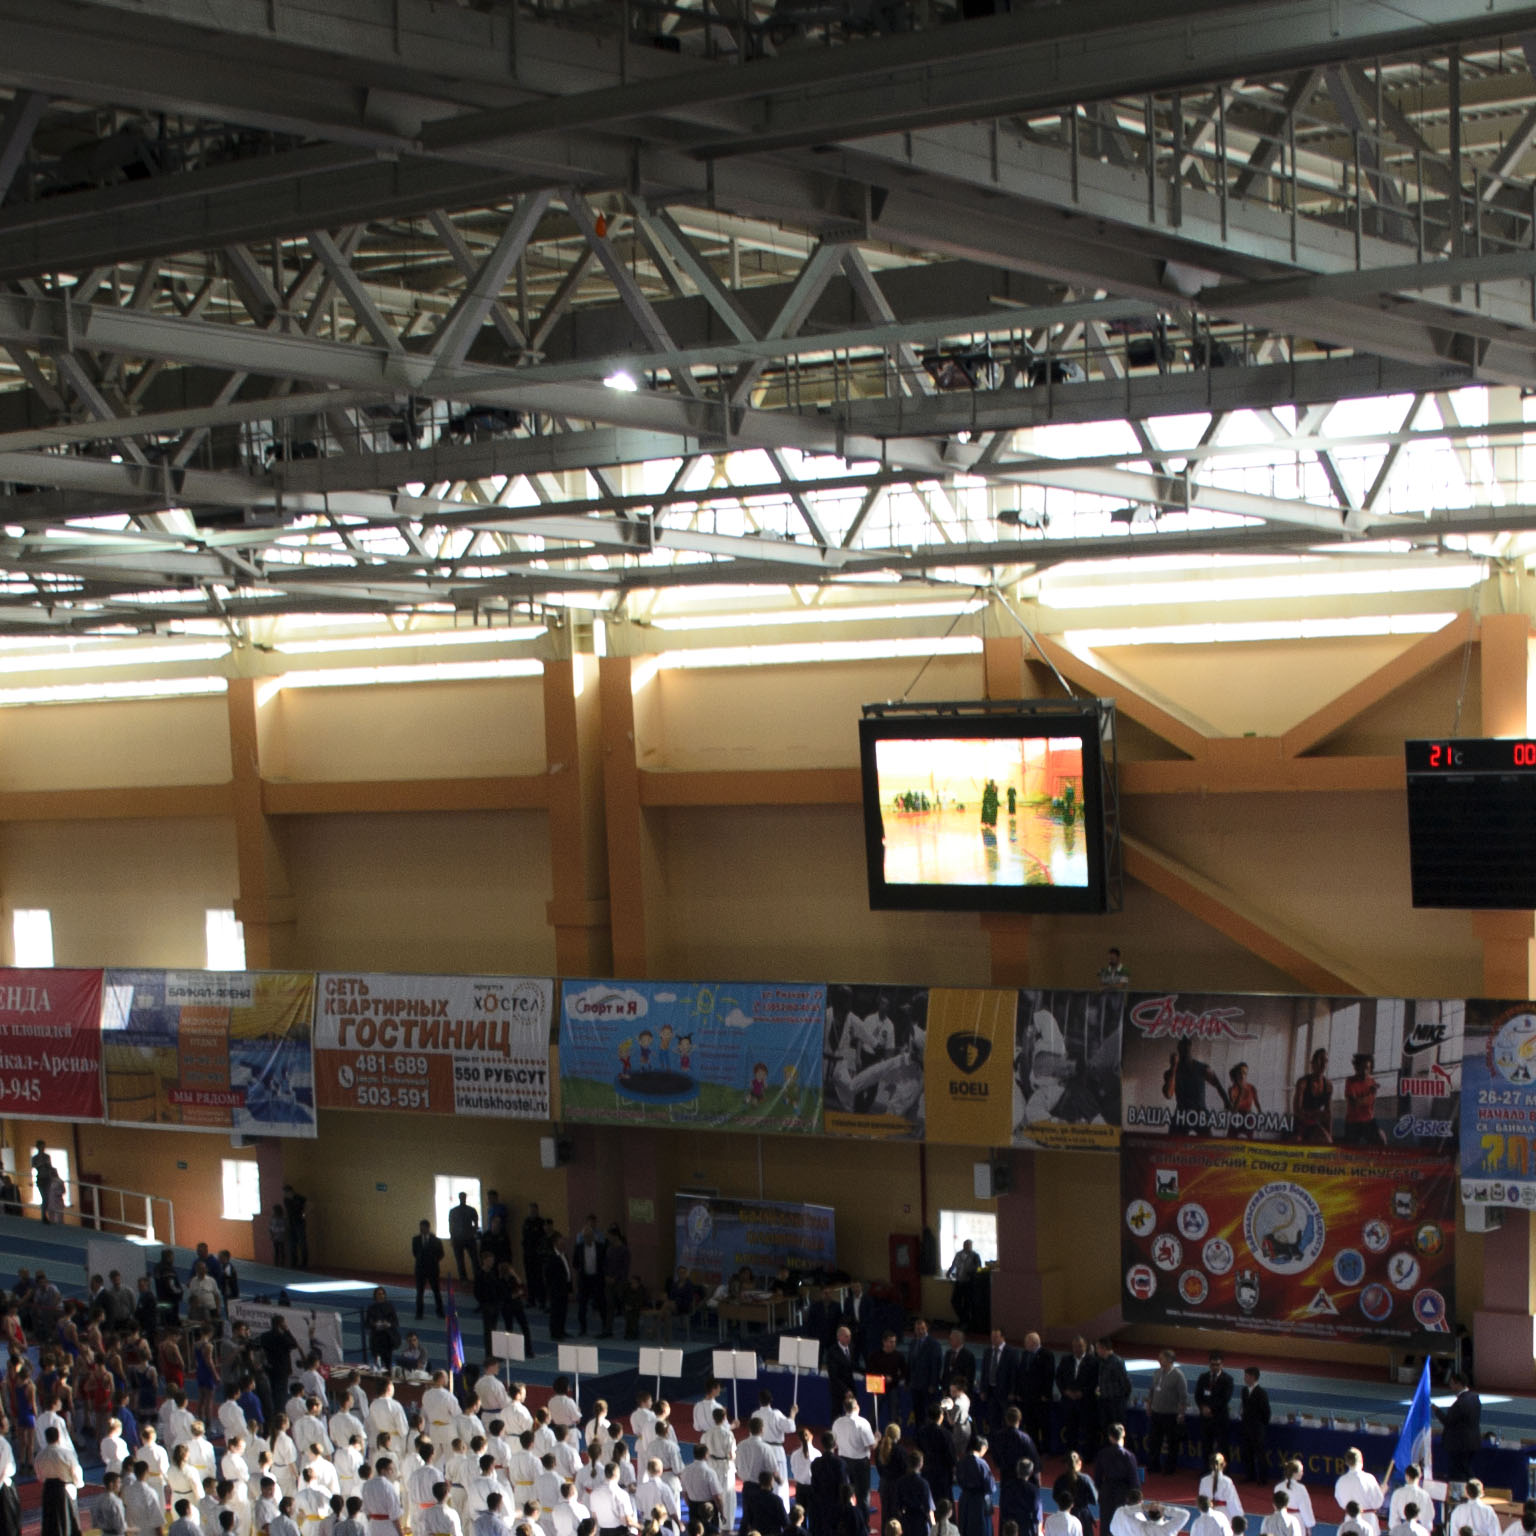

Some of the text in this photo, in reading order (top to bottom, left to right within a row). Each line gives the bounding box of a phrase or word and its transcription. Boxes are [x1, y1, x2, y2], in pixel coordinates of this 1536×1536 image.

[1428, 743, 1453, 768] 21
[325, 978, 369, 996] СЕТЬ
[324, 997, 449, 1018] КВАРТИРНЫХ
[626, 1001, 638, 1014] Я
[11, 1023, 72, 1039] площадей
[337, 1016, 511, 1058] ГОСТИНИЦ
[1411, 1023, 1447, 1042] NIKE
[356, 1054, 429, 1076] 481-689
[455, 1066, 481, 1083] 550
[948, 1081, 989, 1097] БОЕЦ
[1401, 1077, 1448, 1096] PUMA
[173, 1089, 194, 1104] МЫ
[357, 1086, 431, 1109] 503-591
[456, 1094, 548, 1113] irkutskhostel.ru
[1478, 1089, 1522, 1105] 26-27
[1127, 1106, 1294, 1133] ВАША НОВАЯ ФОРМА!
[1478, 1108, 1525, 1121] НАЧАЛО
[1250, 1160, 1289, 1173] СОЮЗ
[1292, 1163, 1346, 1177] БОЕВЫХ
